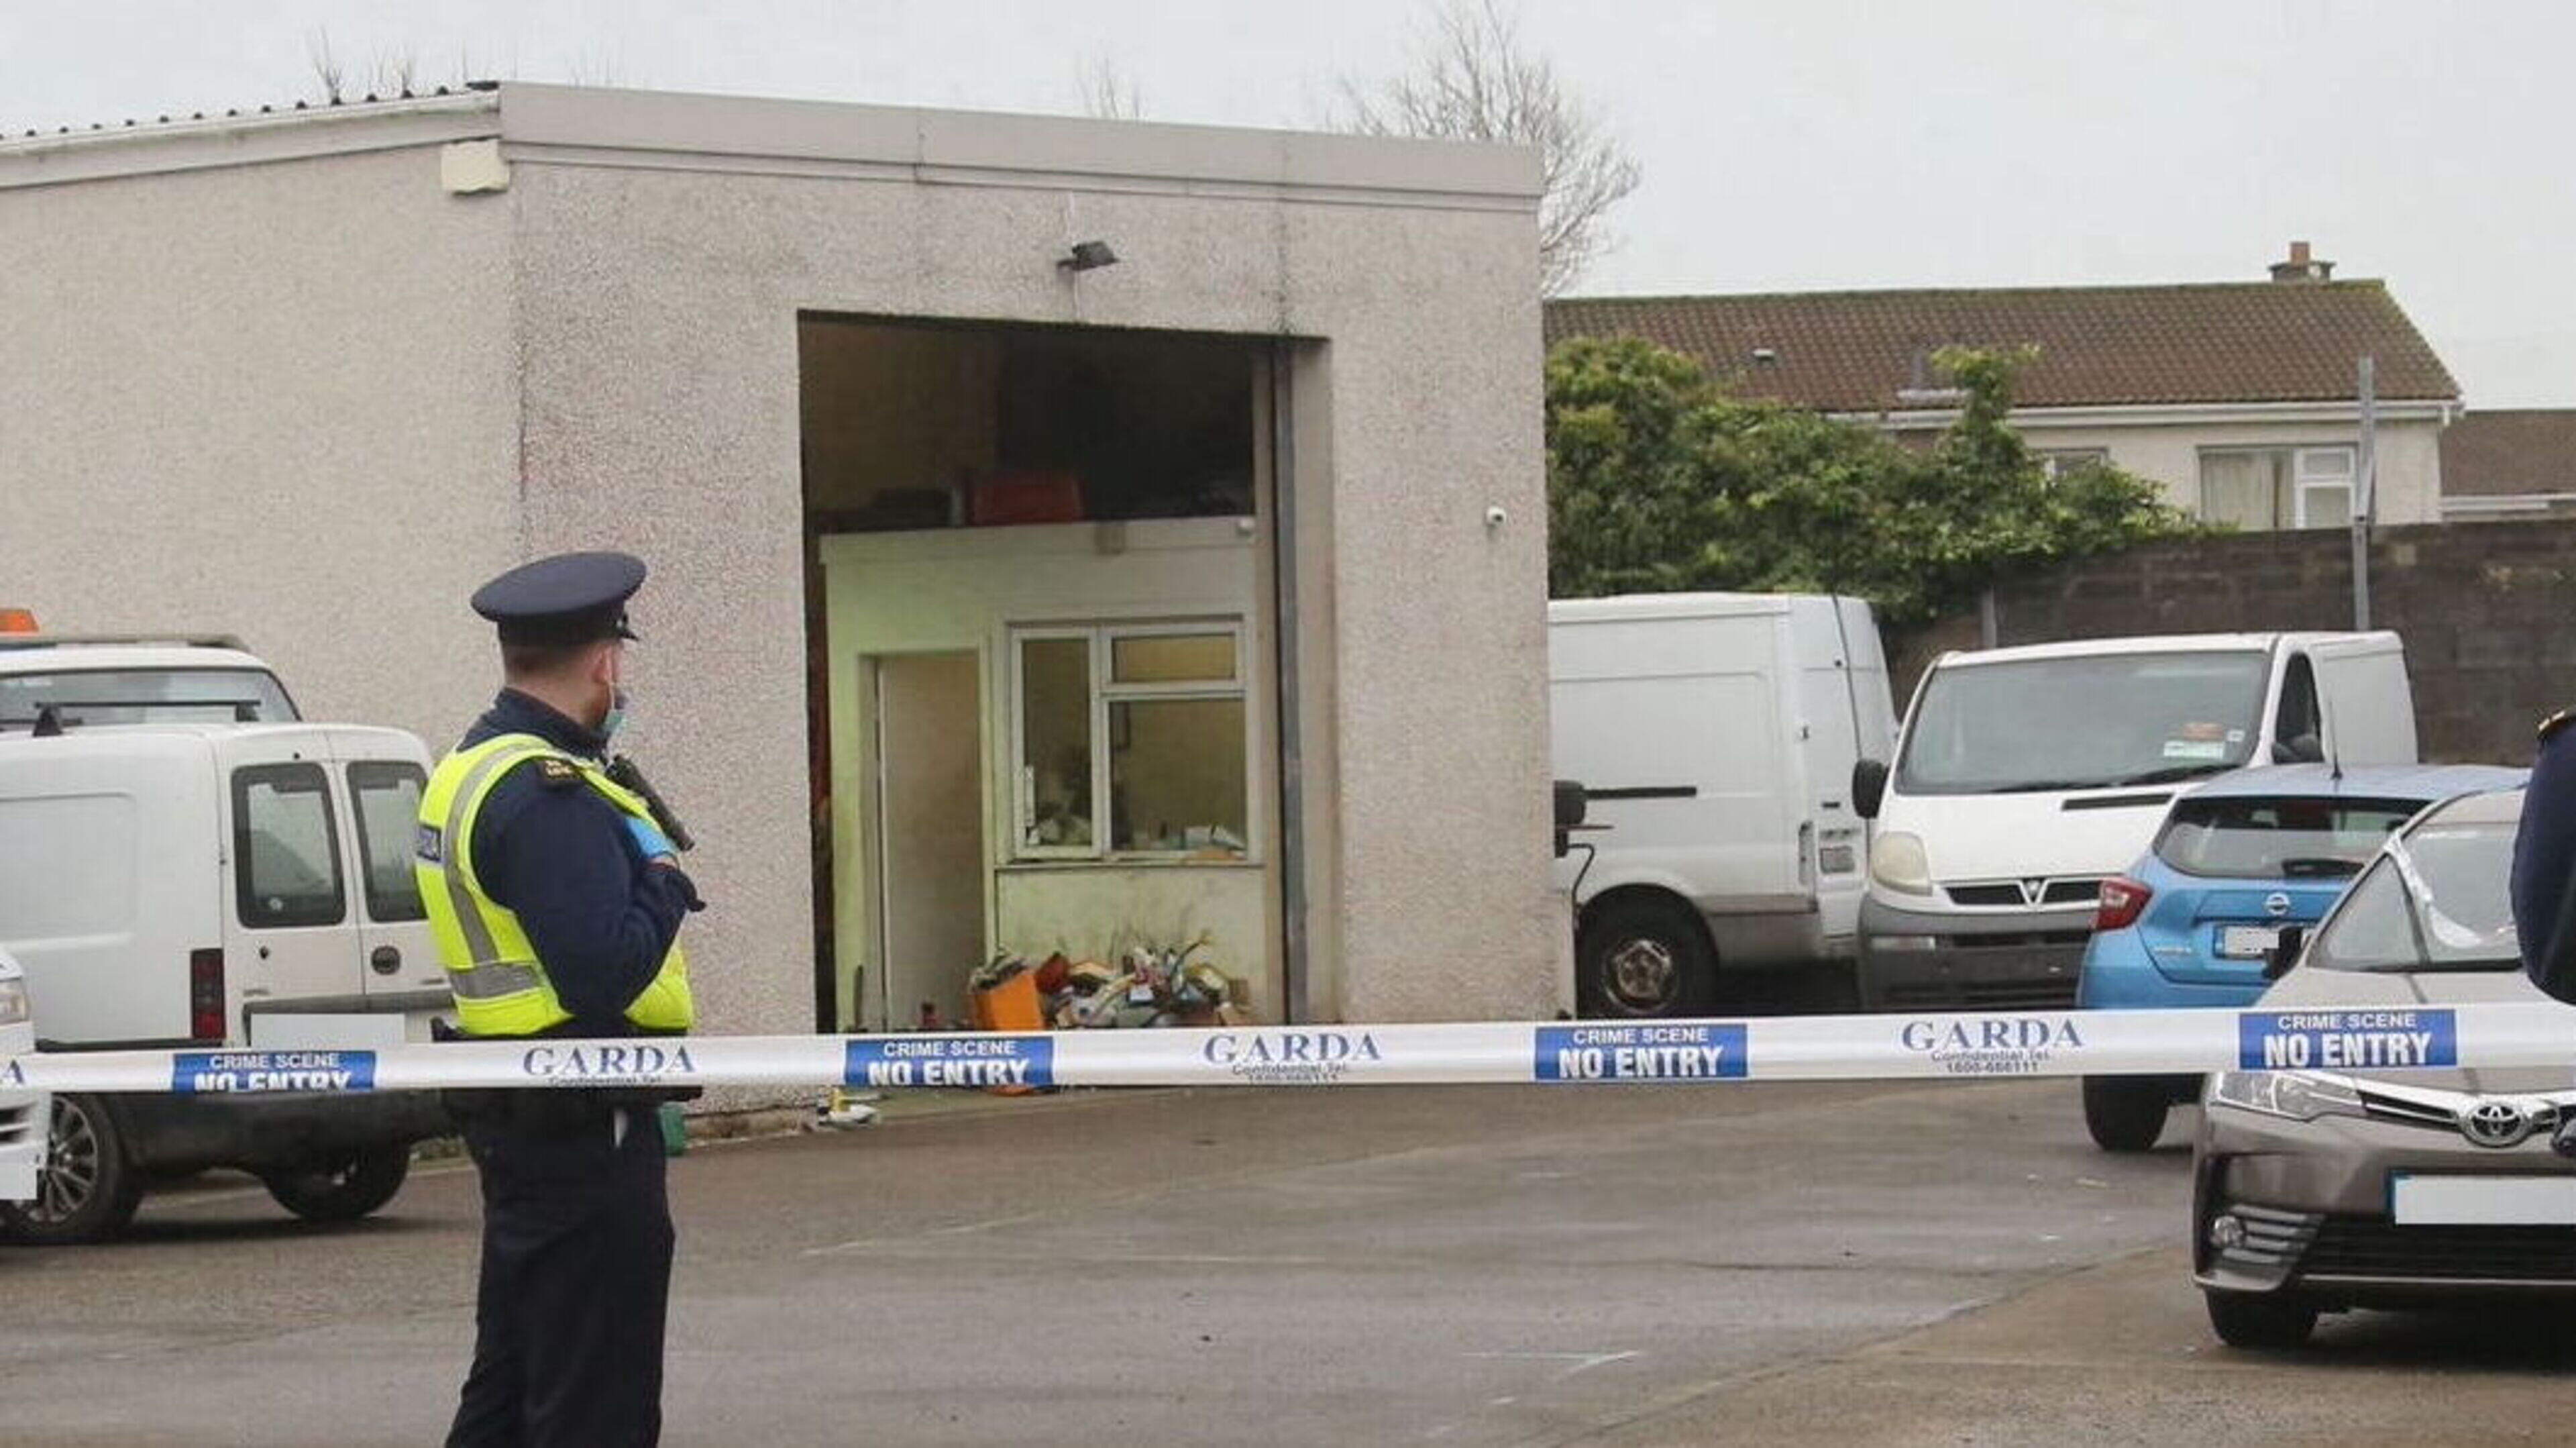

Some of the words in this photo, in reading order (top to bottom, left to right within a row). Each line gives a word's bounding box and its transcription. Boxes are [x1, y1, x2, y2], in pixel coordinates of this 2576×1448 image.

[1573, 1028, 1637, 1044] CRIME
[1642, 1027, 1709, 1043] SCENE
[1902, 1019, 2082, 1050] GARDA
[2278, 1014, 2341, 1030] CRIME
[2347, 1013, 2416, 1029] SCENE
[209, 1055, 269, 1069] CRIME
[274, 1052, 341, 1068] SCENE
[523, 1044, 695, 1076] GARDA
[883, 1040, 945, 1057] CRIME
[950, 1039, 1018, 1056] SCENE
[1203, 1033, 1382, 1063] GARDA
[1558, 1048, 1603, 1078] NO
[1615, 1045, 1724, 1077] ENTRY
[2263, 1034, 2310, 1068] NO
[2322, 1032, 2432, 1066] ENTRY
[867, 1059, 912, 1086] NO
[922, 1057, 1030, 1086] ENTRY
